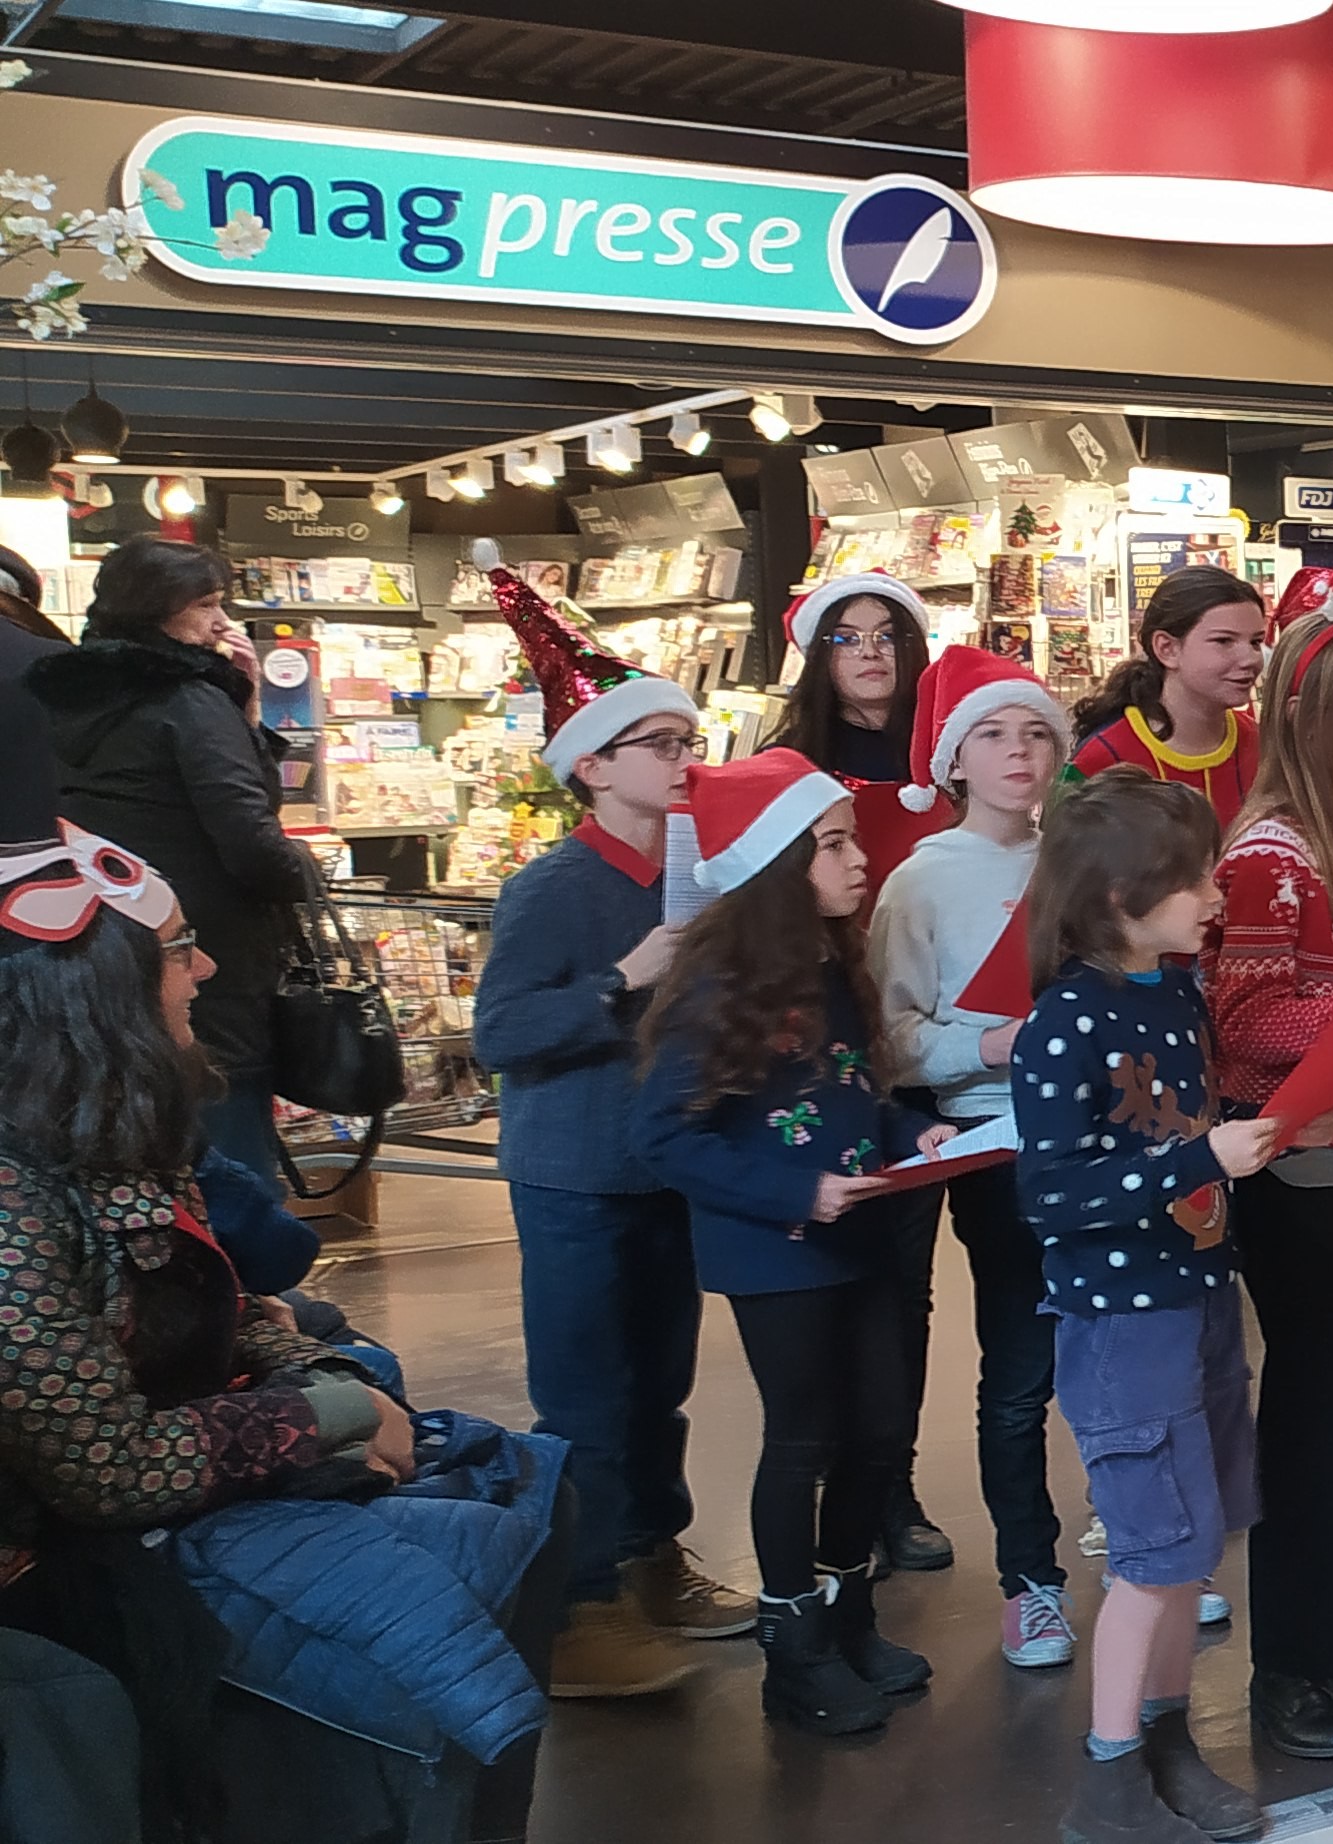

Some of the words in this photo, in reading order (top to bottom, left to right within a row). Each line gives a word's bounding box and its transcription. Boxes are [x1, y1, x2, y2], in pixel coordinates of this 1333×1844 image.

[205, 167, 465, 274] mag
[477, 190, 802, 279] presse
[264, 505, 319, 523] Sports
[292, 522, 345, 537] Loisirs
